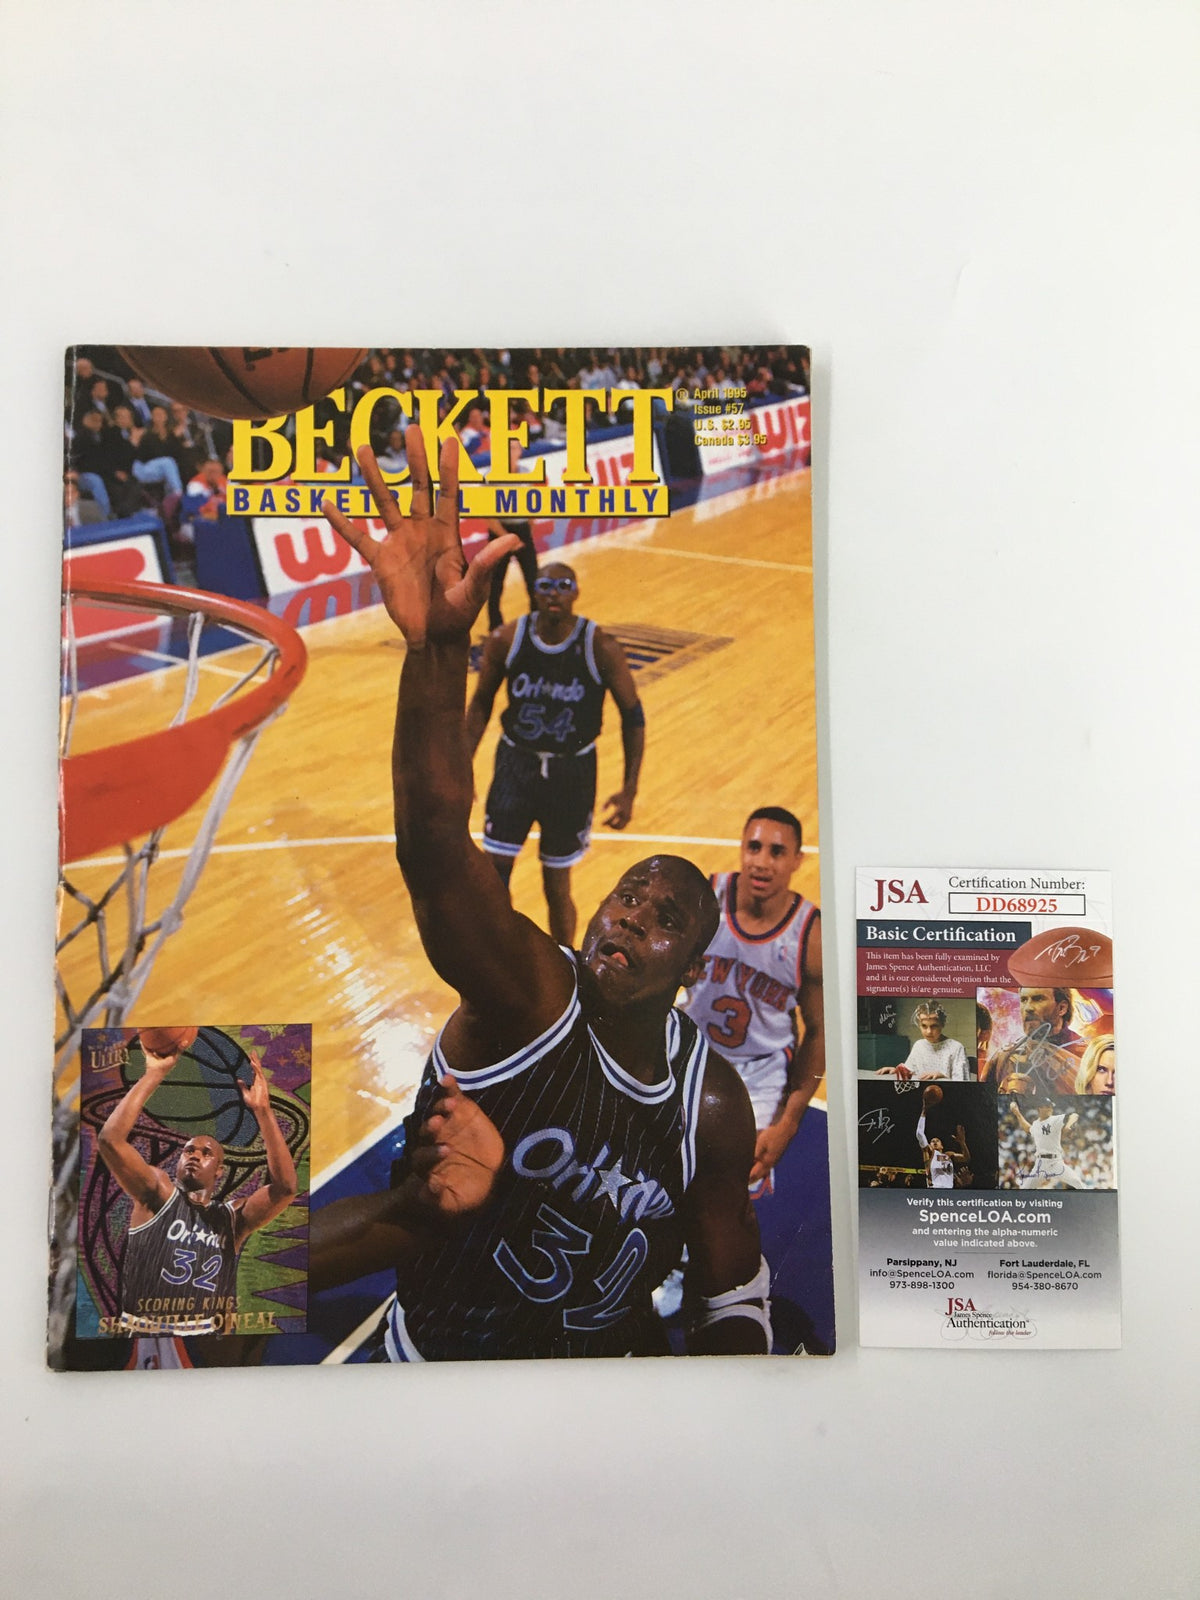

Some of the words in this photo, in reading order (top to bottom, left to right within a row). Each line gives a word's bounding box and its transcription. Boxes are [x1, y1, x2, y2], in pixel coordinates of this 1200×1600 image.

[694, 388, 718, 400] April
[723, 388, 747, 399] 1995
[694, 405, 722, 414] Issue
[726, 403, 744, 414] #57
[694, 420, 718, 430] U.S.
[722, 419, 751, 431] $2.95
[227, 386, 673, 482] BECKETT
[694, 435, 734, 446] Canada
[738, 434, 767, 446] $3.95
[496, 489, 658, 513] MONTHLY
[513, 704, 577, 742] 54
[949, 877, 1026, 889] Certification
[1030, 878, 1086, 890] Number:
[870, 880, 929, 912] JSA
[976, 897, 1058, 913] DD68925
[866, 926, 909, 941] Basic
[913, 927, 1016, 942] Certification
[866, 952, 881, 960] This
[884, 952, 900, 960] item
[902, 952, 914, 960] has
[916, 952, 933, 960] been
[935, 952, 950, 962] fully
[954, 953, 990, 961] examined
[990, 954, 1000, 963] by
[866, 963, 888, 971] James
[889, 964, 914, 972] Spence
[917, 964, 974, 972] Authentication,
[975, 964, 991, 972] LLC
[952, 976, 983, 984] opinion
[866, 985, 909, 993] signature(s)
[932, 986, 964, 994] genuine.
[707, 995, 752, 1049] 3
[906, 1198, 934, 1208] Verify
[937, 1198, 954, 1206] this
[956, 1199, 1012, 1207] certification
[1015, 1200, 1026, 1208] by
[1030, 1200, 1063, 1208] visiting
[920, 1210, 1051, 1224] SpenceLOA.com
[912, 1227, 930, 1235] and
[932, 1228, 972, 1236] entering
[974, 1228, 989, 1236] the
[992, 1228, 1058, 1237] alpha-numeric
[933, 1239, 958, 1247] value
[961, 1239, 1004, 1247] indicated
[1008, 1240, 1038, 1248] above.
[493, 1203, 648, 1330] 32
[886, 1258, 942, 1268] Parsippany,
[1022, 1260, 1076, 1268] Lauderdale,
[161, 1248, 222, 1292] 32
[870, 1269, 974, 1279] info@SpenceLOA.com
[988, 1271, 1102, 1280] florida@SpenceLOA.com
[890, 1281, 954, 1290] 973-898-1300
[1012, 1282, 1078, 1290] 954-380-8670
[137, 1297, 195, 1312] SCORING
[202, 1296, 242, 1310] KINGS
[945, 1298, 976, 1315] JSA
